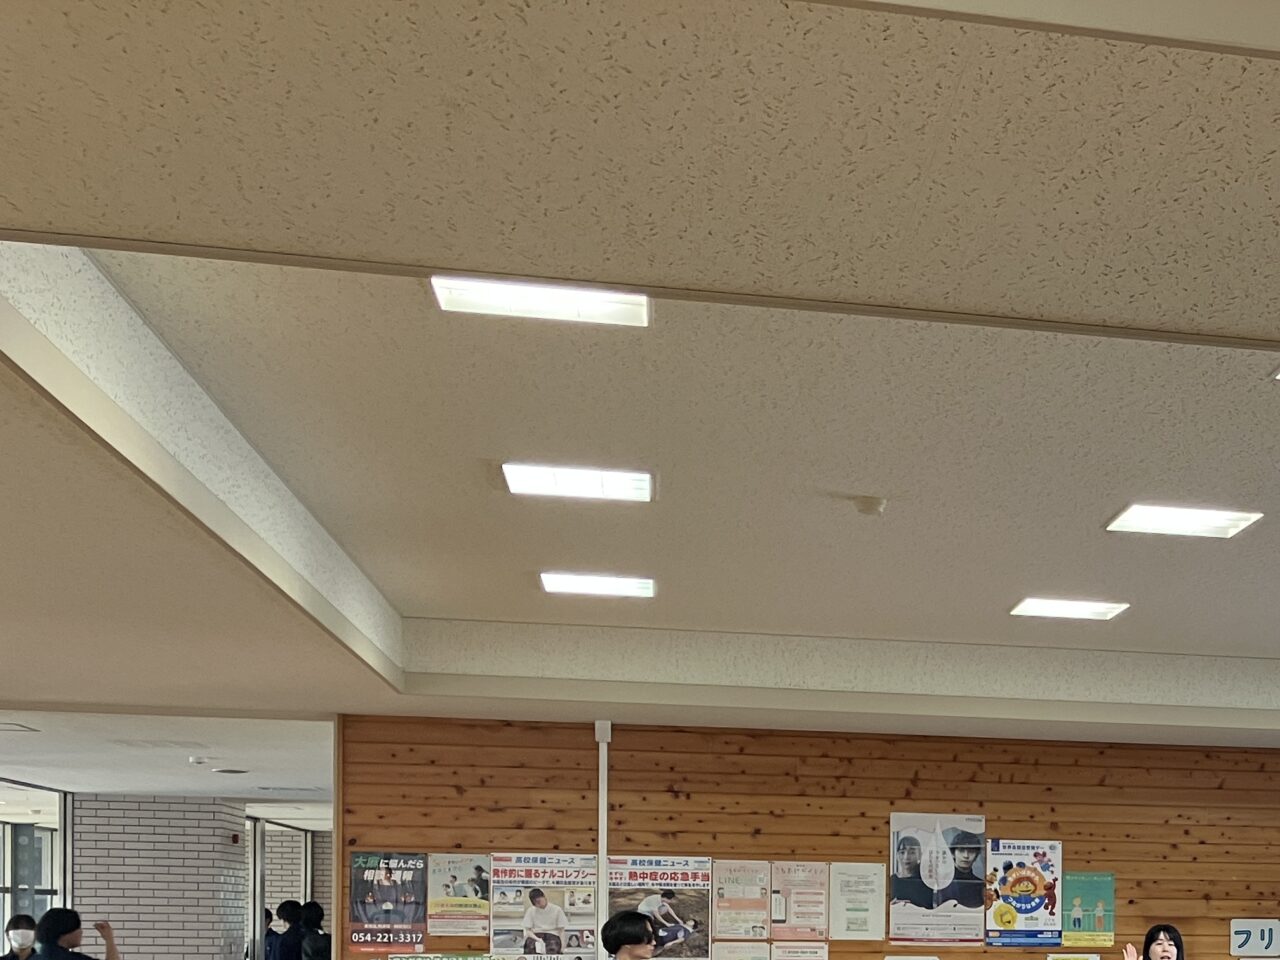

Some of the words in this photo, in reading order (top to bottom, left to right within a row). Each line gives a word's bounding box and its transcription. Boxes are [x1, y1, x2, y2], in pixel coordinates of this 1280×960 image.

[515, 856, 576, 864] 高校保健ニュース
[631, 859, 689, 867] 高校保健ニュース
[628, 871, 710, 882] 熱中症の応急手当
[352, 933, 423, 943] 054-221-3317
